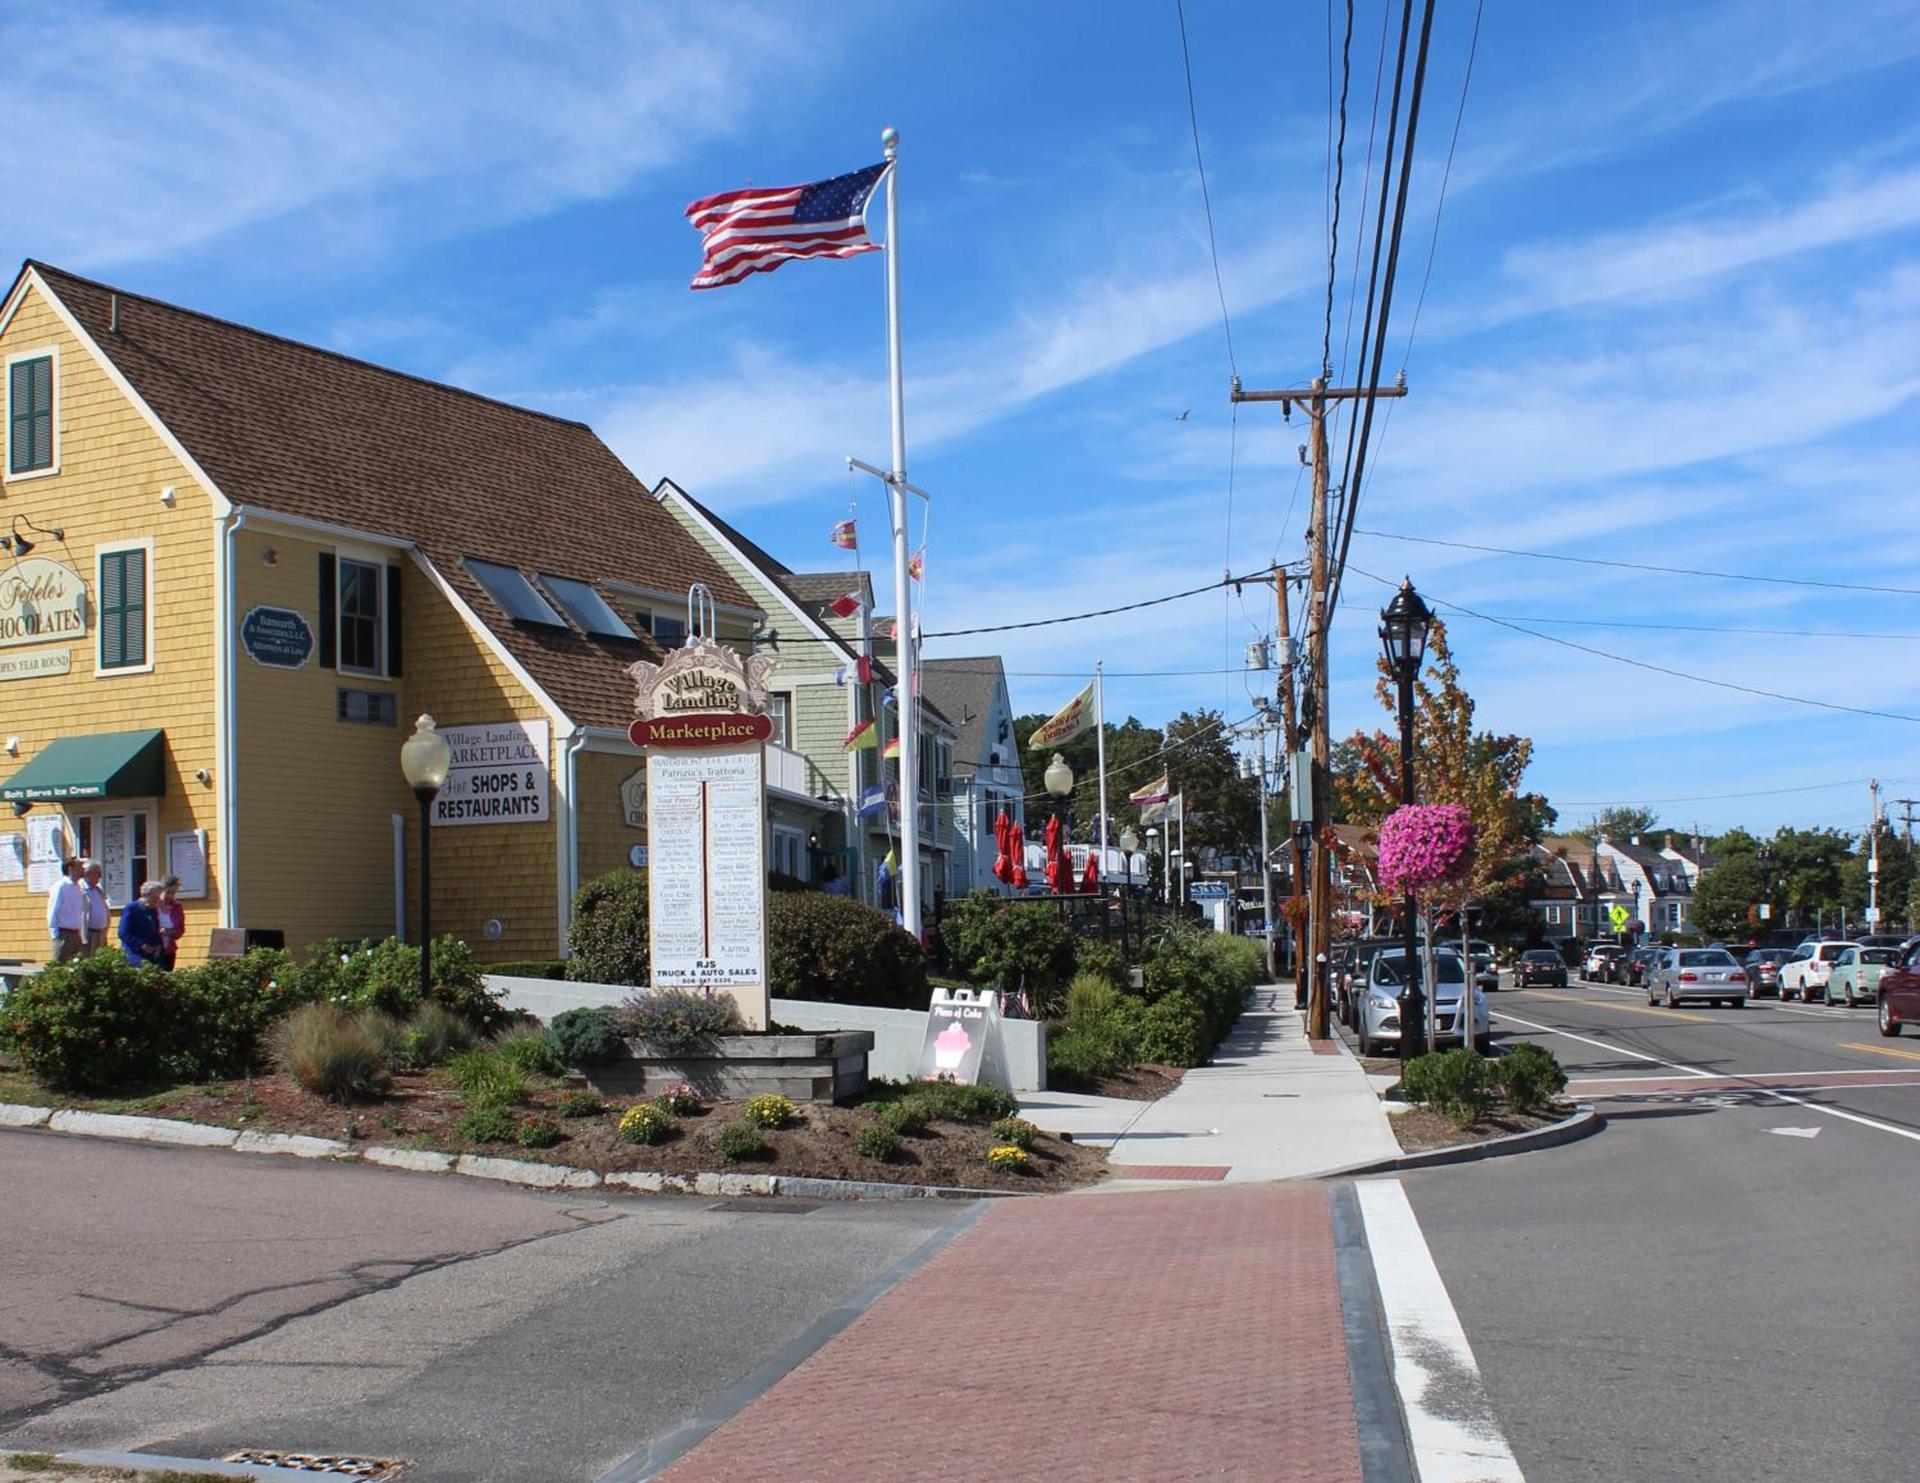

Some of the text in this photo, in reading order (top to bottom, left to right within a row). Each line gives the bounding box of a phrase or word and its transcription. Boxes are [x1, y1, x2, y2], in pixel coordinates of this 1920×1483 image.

[0, 608, 80, 639] HOCOLATES
[664, 669, 736, 694] Village
[662, 690, 739, 711] Landing
[446, 729, 529, 745] Village Landing
[649, 721, 755, 741] Marketplace
[450, 744, 539, 763] ARKETPLACE
[4, 790, 24, 799] Soft
[26, 789, 52, 797] Serve
[69, 786, 99, 794] Cream
[471, 772, 518, 794] SHOPS
[526, 771, 535, 790] &
[438, 795, 540, 819] RESTAURANTS
[696, 961, 717, 969] RJS
[728, 968, 758, 976] SALES
